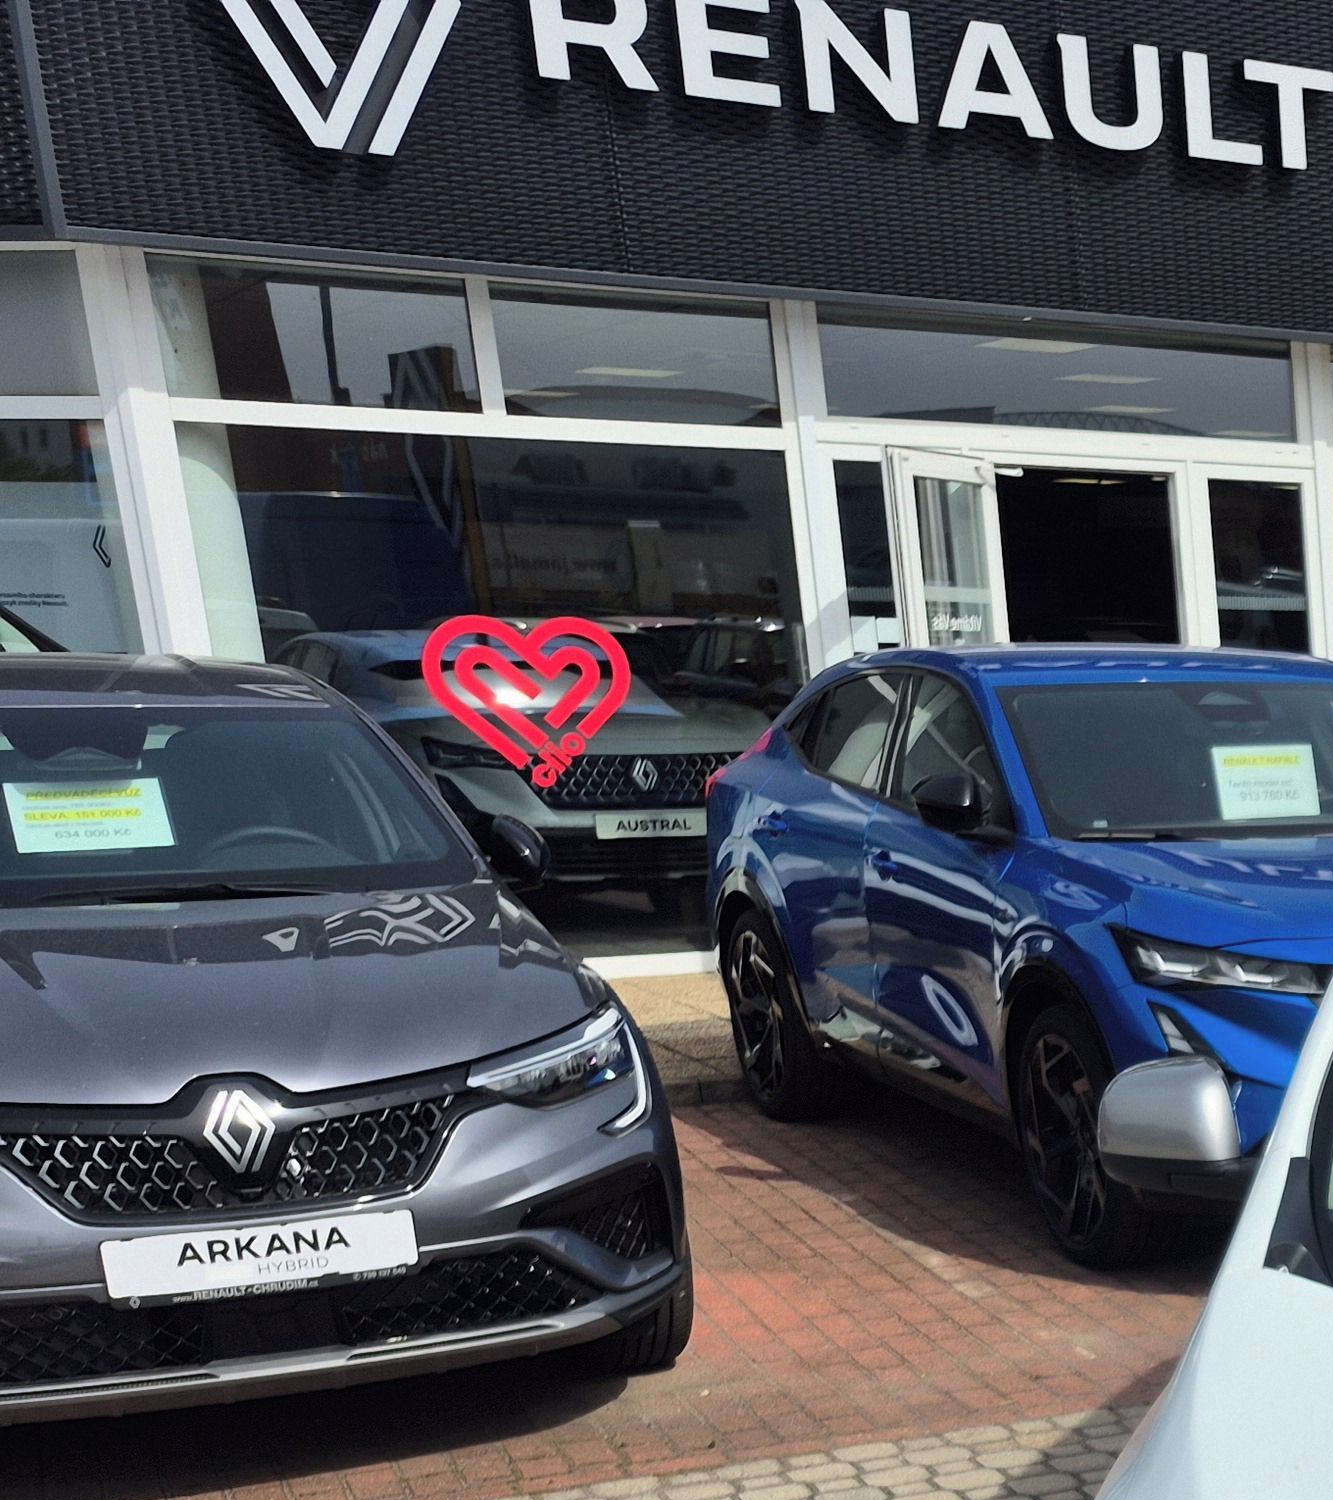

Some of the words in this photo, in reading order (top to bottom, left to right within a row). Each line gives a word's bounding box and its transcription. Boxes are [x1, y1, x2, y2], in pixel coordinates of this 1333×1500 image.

[84, 828, 109, 838] 000
[616, 818, 692, 832] AUSTRAL
[176, 1226, 351, 1267] ARKANA
[257, 1255, 330, 1276] HYBRID
